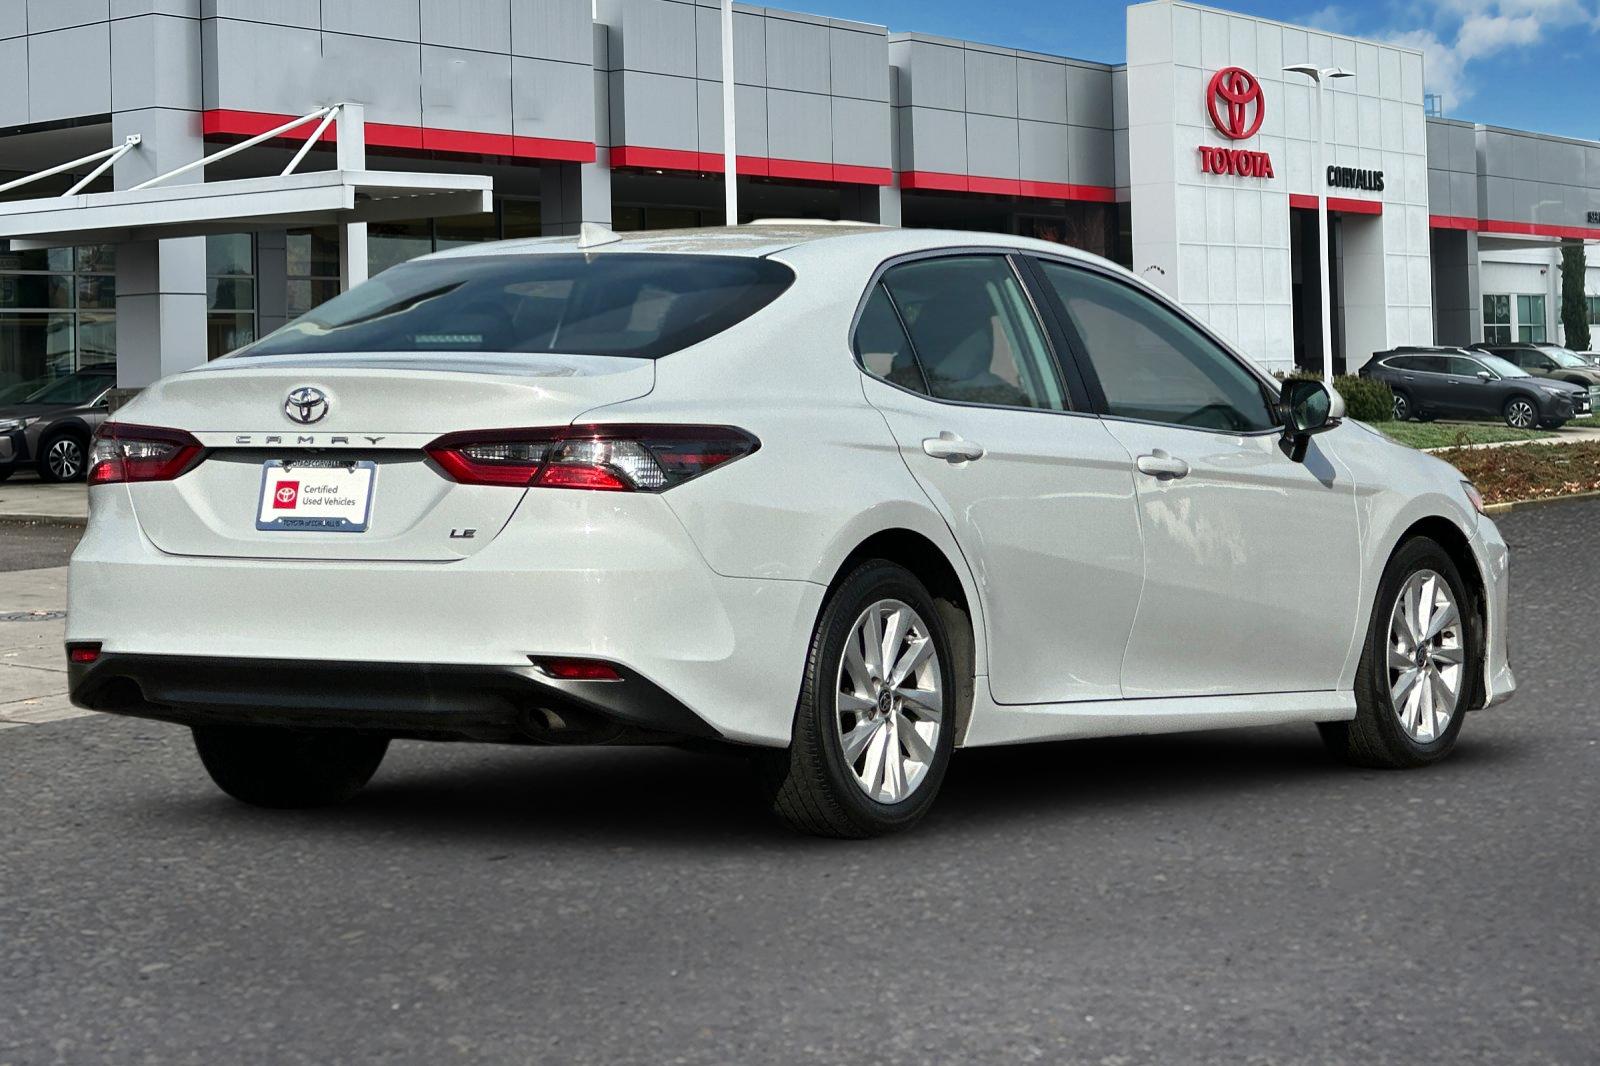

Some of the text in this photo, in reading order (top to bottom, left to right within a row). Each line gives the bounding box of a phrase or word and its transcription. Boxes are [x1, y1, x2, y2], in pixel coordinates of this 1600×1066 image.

[1199, 146, 1274, 178] TOYOTA
[1327, 165, 1384, 191] CORVALLIS
[236, 435, 385, 446] CAMRY
[304, 485, 338, 494] Certified
[302, 497, 356, 507] Used Vehicles
[449, 528, 477, 539] LE
